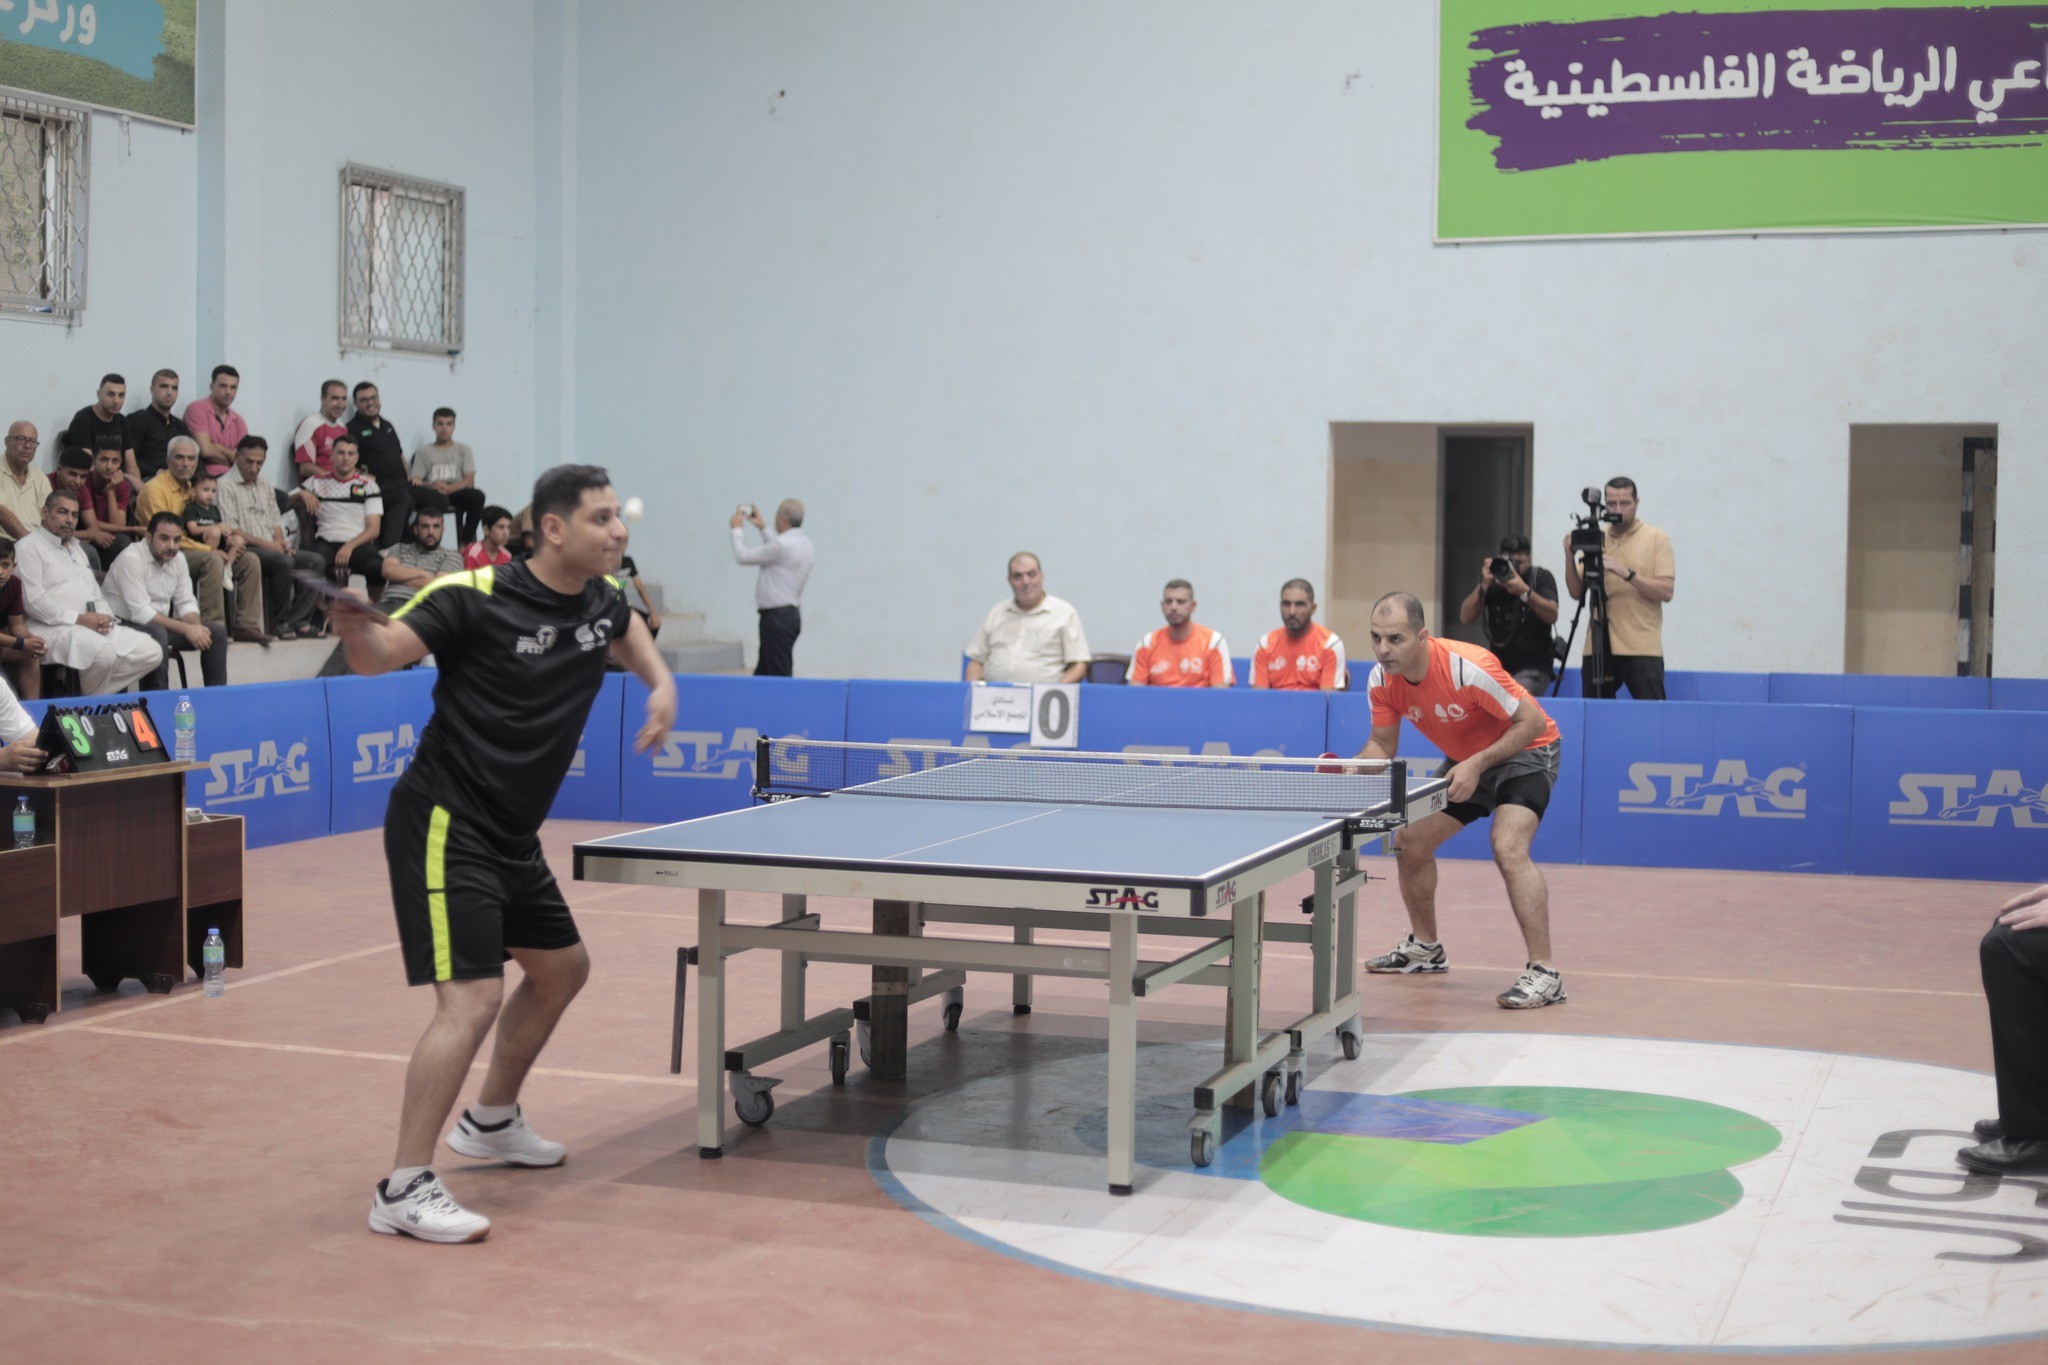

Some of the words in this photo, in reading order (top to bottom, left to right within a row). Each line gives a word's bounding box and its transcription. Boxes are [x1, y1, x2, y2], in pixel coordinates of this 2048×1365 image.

[1504, 52, 1775, 120] الفلسطينية
[1787, 46, 1957, 107] الرياضة
[1968, 41, 2048, 124] عي
[80, 715, 94, 736] 0
[113, 712, 127, 734] 0
[131, 711, 158, 749] 4
[1038, 688, 1070, 740] 0
[61, 716, 90, 754] 3
[353, 724, 419, 783] STA
[106, 748, 129, 762] STAG
[204, 740, 310, 806] STAG
[1618, 759, 1807, 819] STAG
[1359, 819, 1384, 828] STAG
[1086, 887, 1159, 911] STAG
[1215, 880, 1237, 908] STAG
